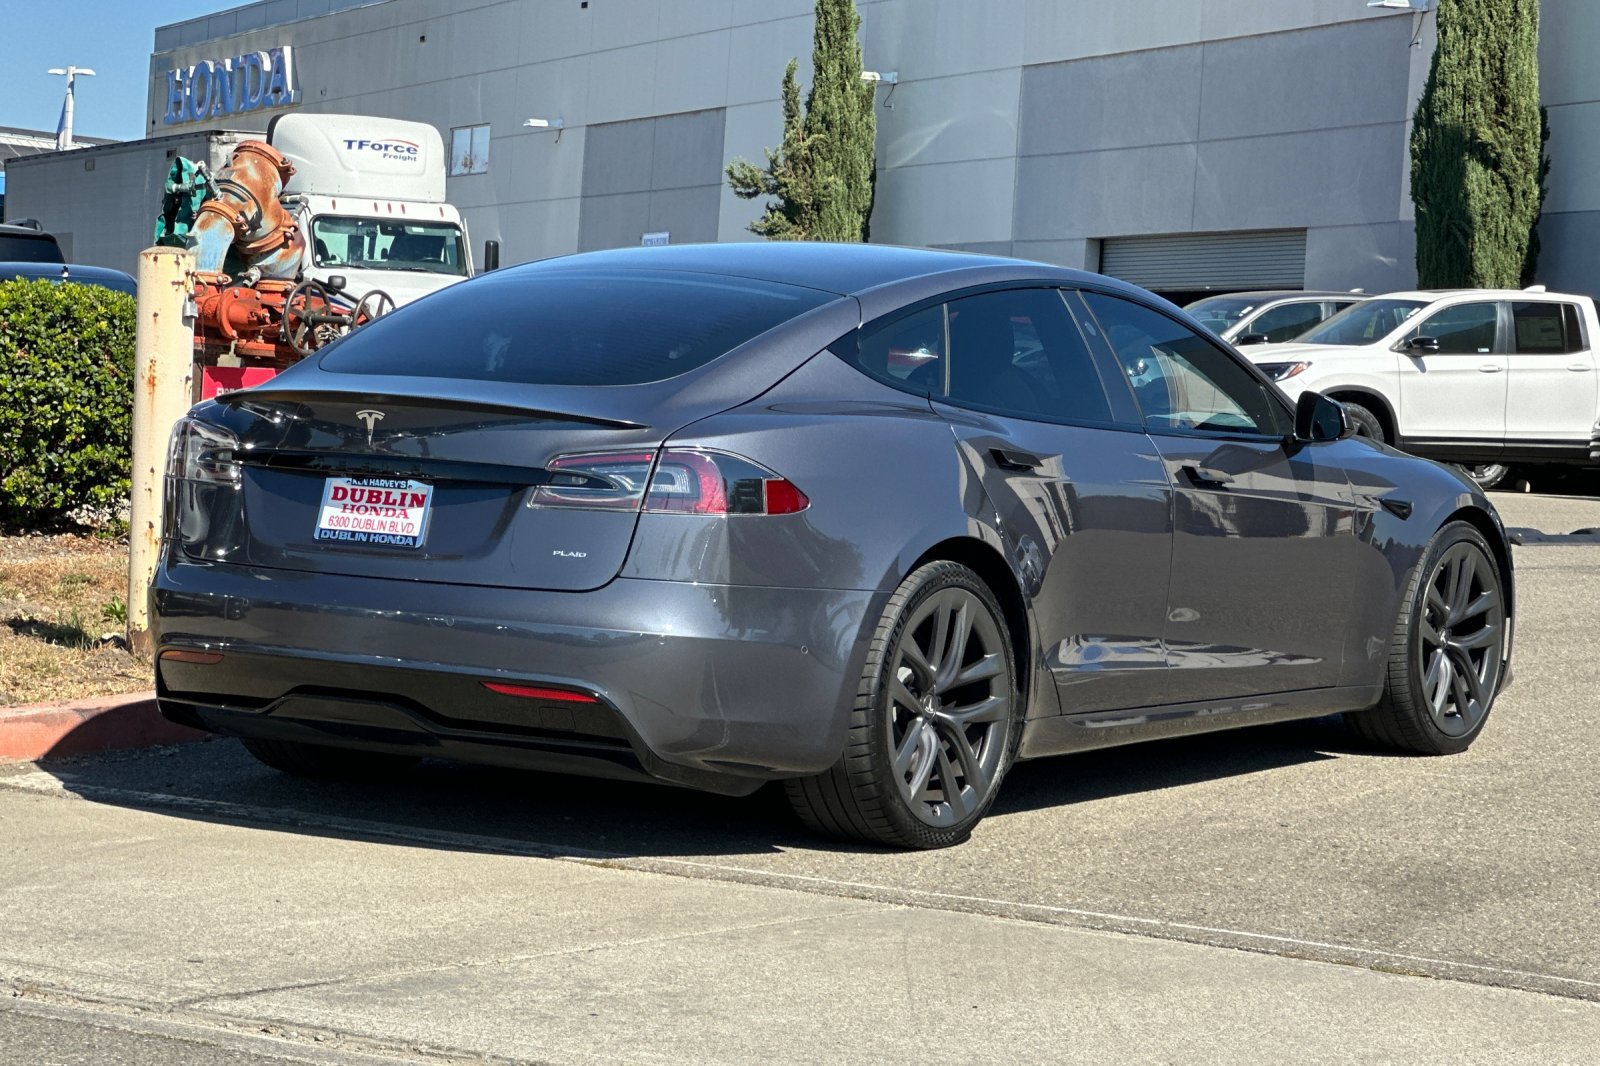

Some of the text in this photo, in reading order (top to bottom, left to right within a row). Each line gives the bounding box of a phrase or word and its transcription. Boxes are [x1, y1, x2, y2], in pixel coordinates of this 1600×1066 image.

[164, 46, 293, 124] HONDA
[343, 139, 418, 155] TForce
[383, 153, 417, 161] Freight
[370, 479, 407, 490] HARVEY'S
[331, 486, 426, 508] DUBLIN
[341, 503, 410, 519] HONDA
[328, 515, 416, 534] 6300 DUBLIN BLVD.
[320, 529, 414, 546] DUBLIN HONDA
[552, 550, 587, 558] PLAID
